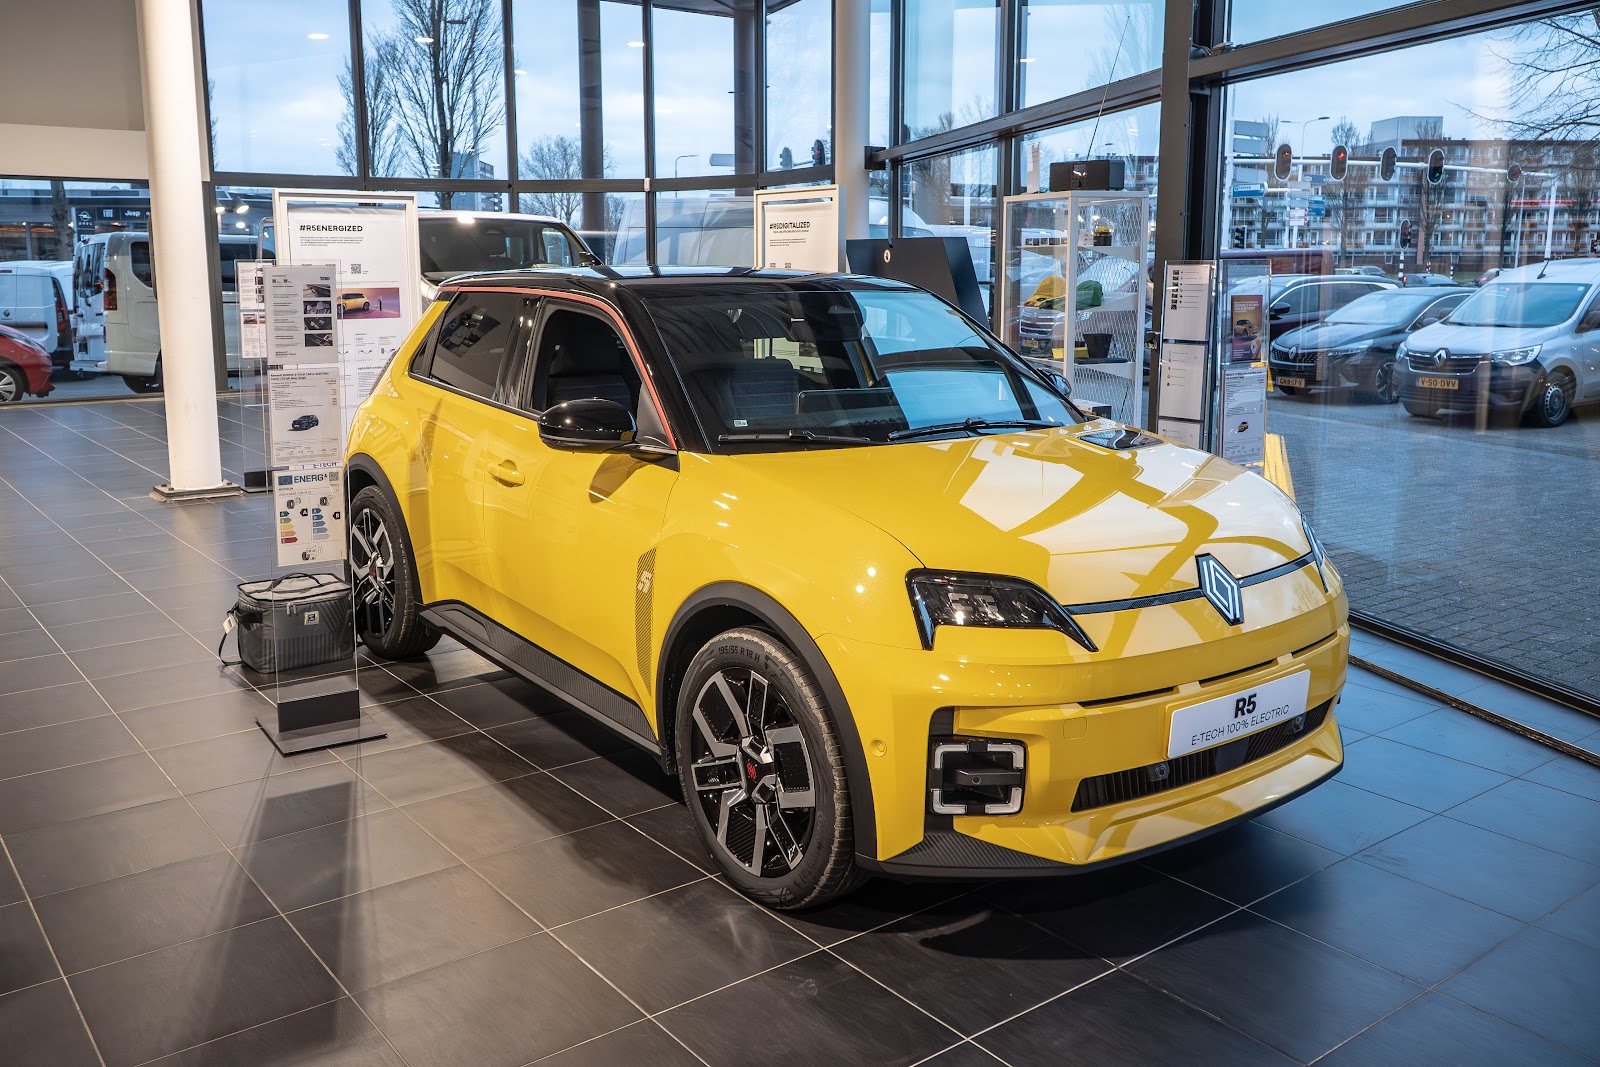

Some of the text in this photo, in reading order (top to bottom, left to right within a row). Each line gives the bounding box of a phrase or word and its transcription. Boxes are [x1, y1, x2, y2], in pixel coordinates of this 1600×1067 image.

[719, 645, 739, 654] 195/55
[1234, 693, 1257, 718] R5
[1192, 704, 1289, 746] E-TECH 100% ELECTRIC
